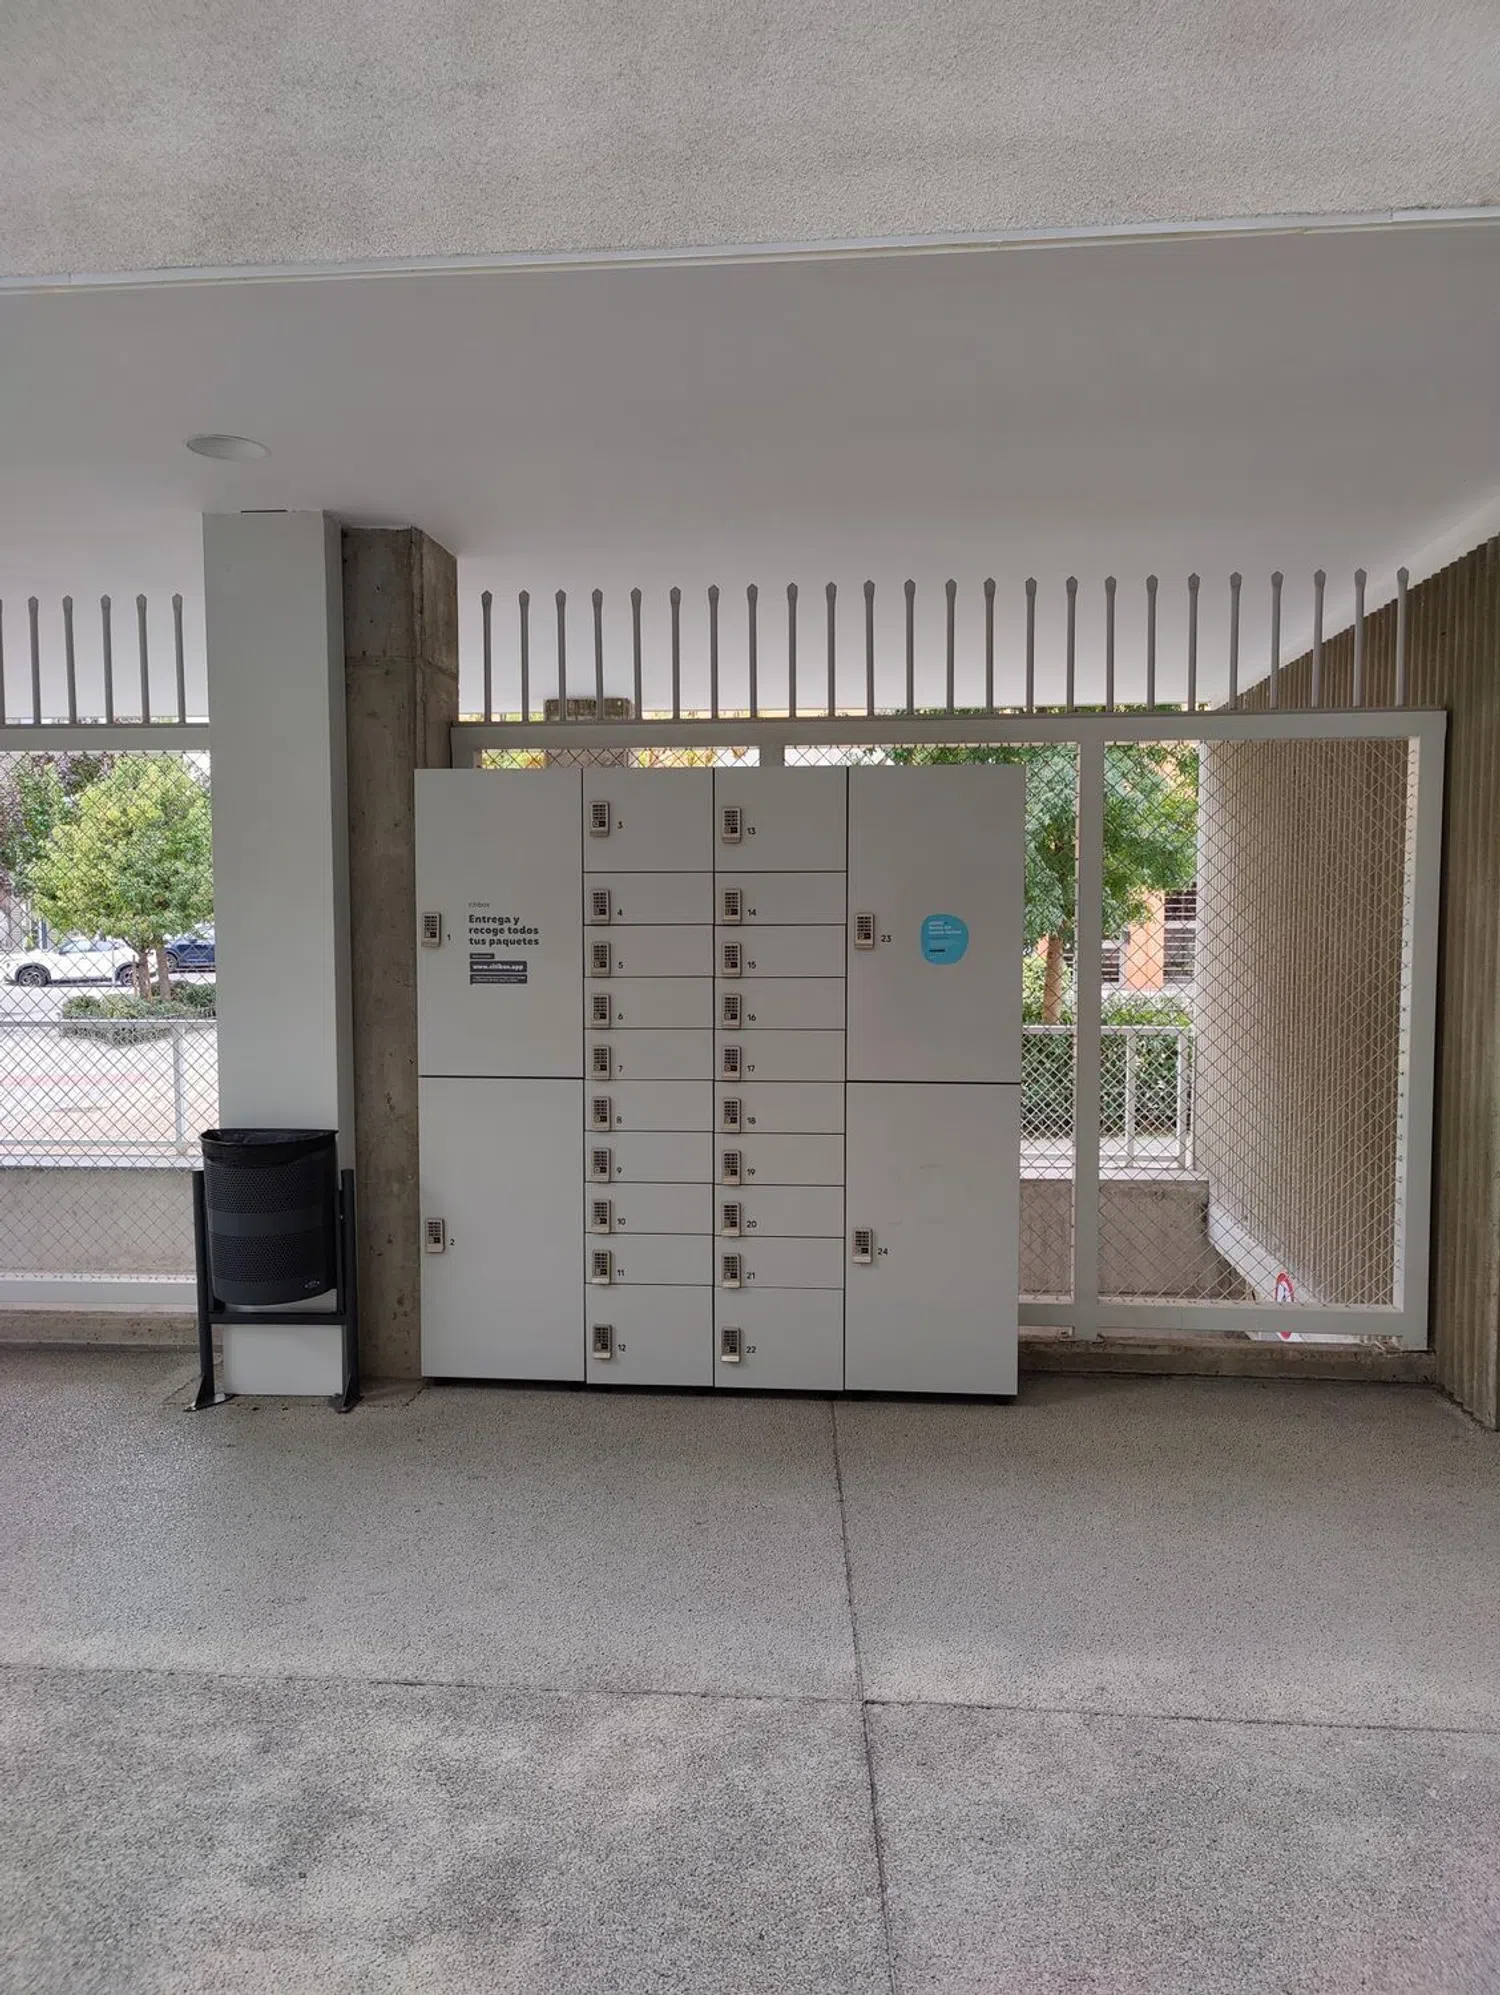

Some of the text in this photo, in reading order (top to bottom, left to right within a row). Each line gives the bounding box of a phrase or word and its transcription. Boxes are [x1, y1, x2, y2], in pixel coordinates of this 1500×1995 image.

[746, 826, 757, 836] 13
[747, 908, 757, 917] 14
[468, 914, 520, 926] Entrega y
[468, 925, 539, 936] recoge todos
[469, 937, 540, 948] tus paquetes
[880, 934, 892, 943] 23
[747, 960, 757, 970] 15
[746, 1013, 757, 1022] 16
[746, 1064, 756, 1073] 17
[746, 1116, 757, 1125] 18
[746, 1168, 757, 1177] 19
[616, 1217, 627, 1226] 10
[746, 1219, 758, 1229] 20
[877, 1247, 889, 1256] 24
[616, 1268, 625, 1277] 11
[745, 1271, 756, 1280] 21
[617, 1343, 627, 1353] 12
[745, 1345, 757, 1354] 22
